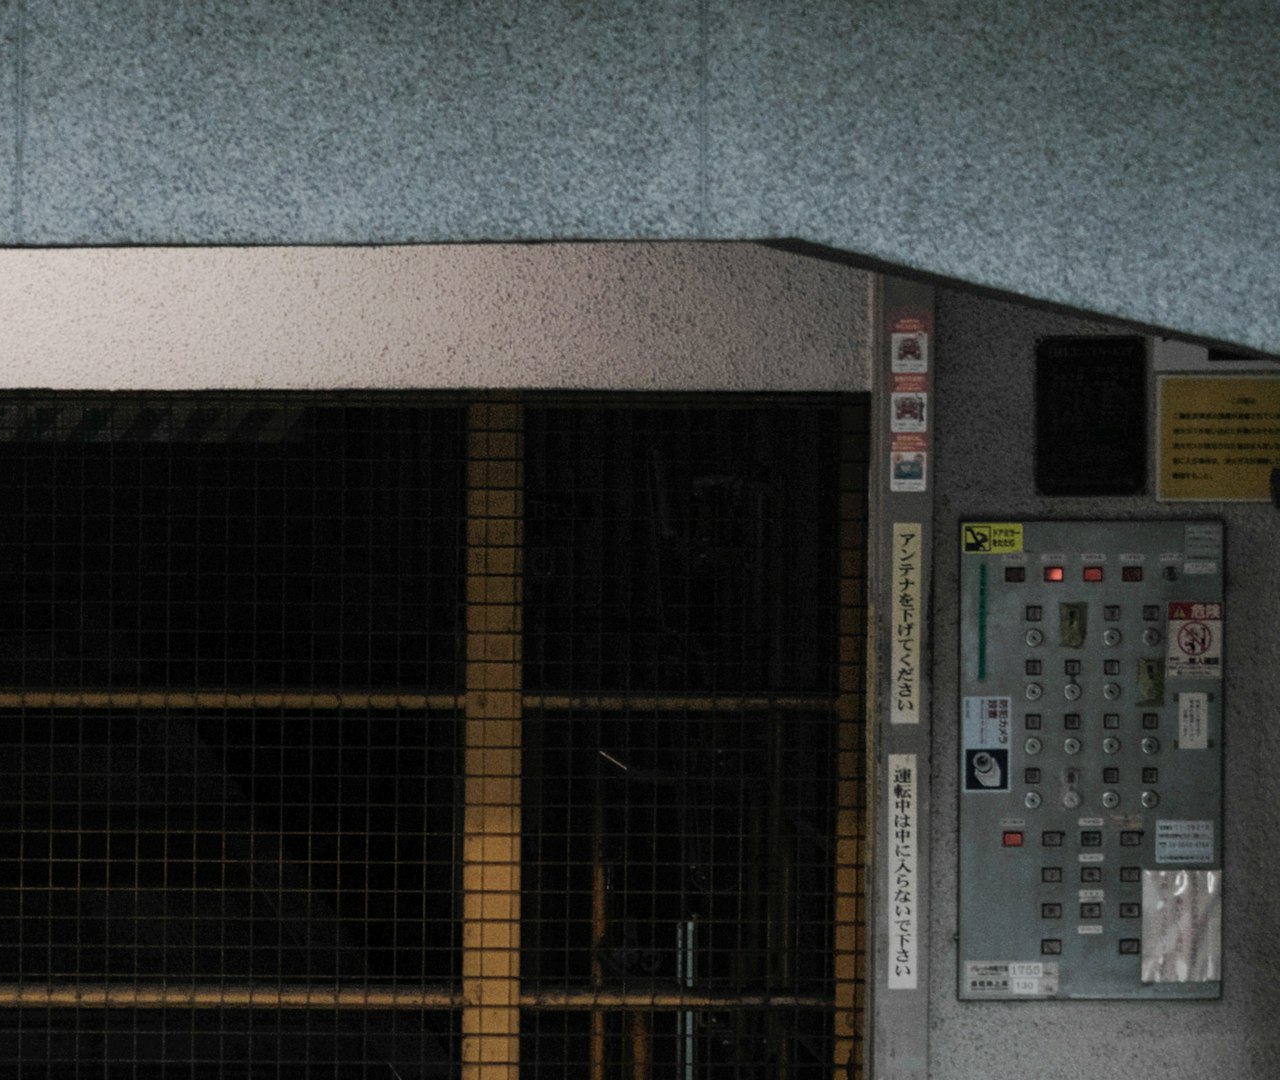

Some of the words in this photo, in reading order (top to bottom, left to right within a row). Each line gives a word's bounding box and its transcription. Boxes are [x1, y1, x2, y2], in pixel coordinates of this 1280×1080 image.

[1191, 603, 1221, 619] 危険
[896, 533, 916, 711] アンテナを下げてください
[893, 768, 912, 977] 運転中は中に入らないで下さい
[1011, 965, 1041, 975] 1755
[1016, 982, 1034, 990] 130
